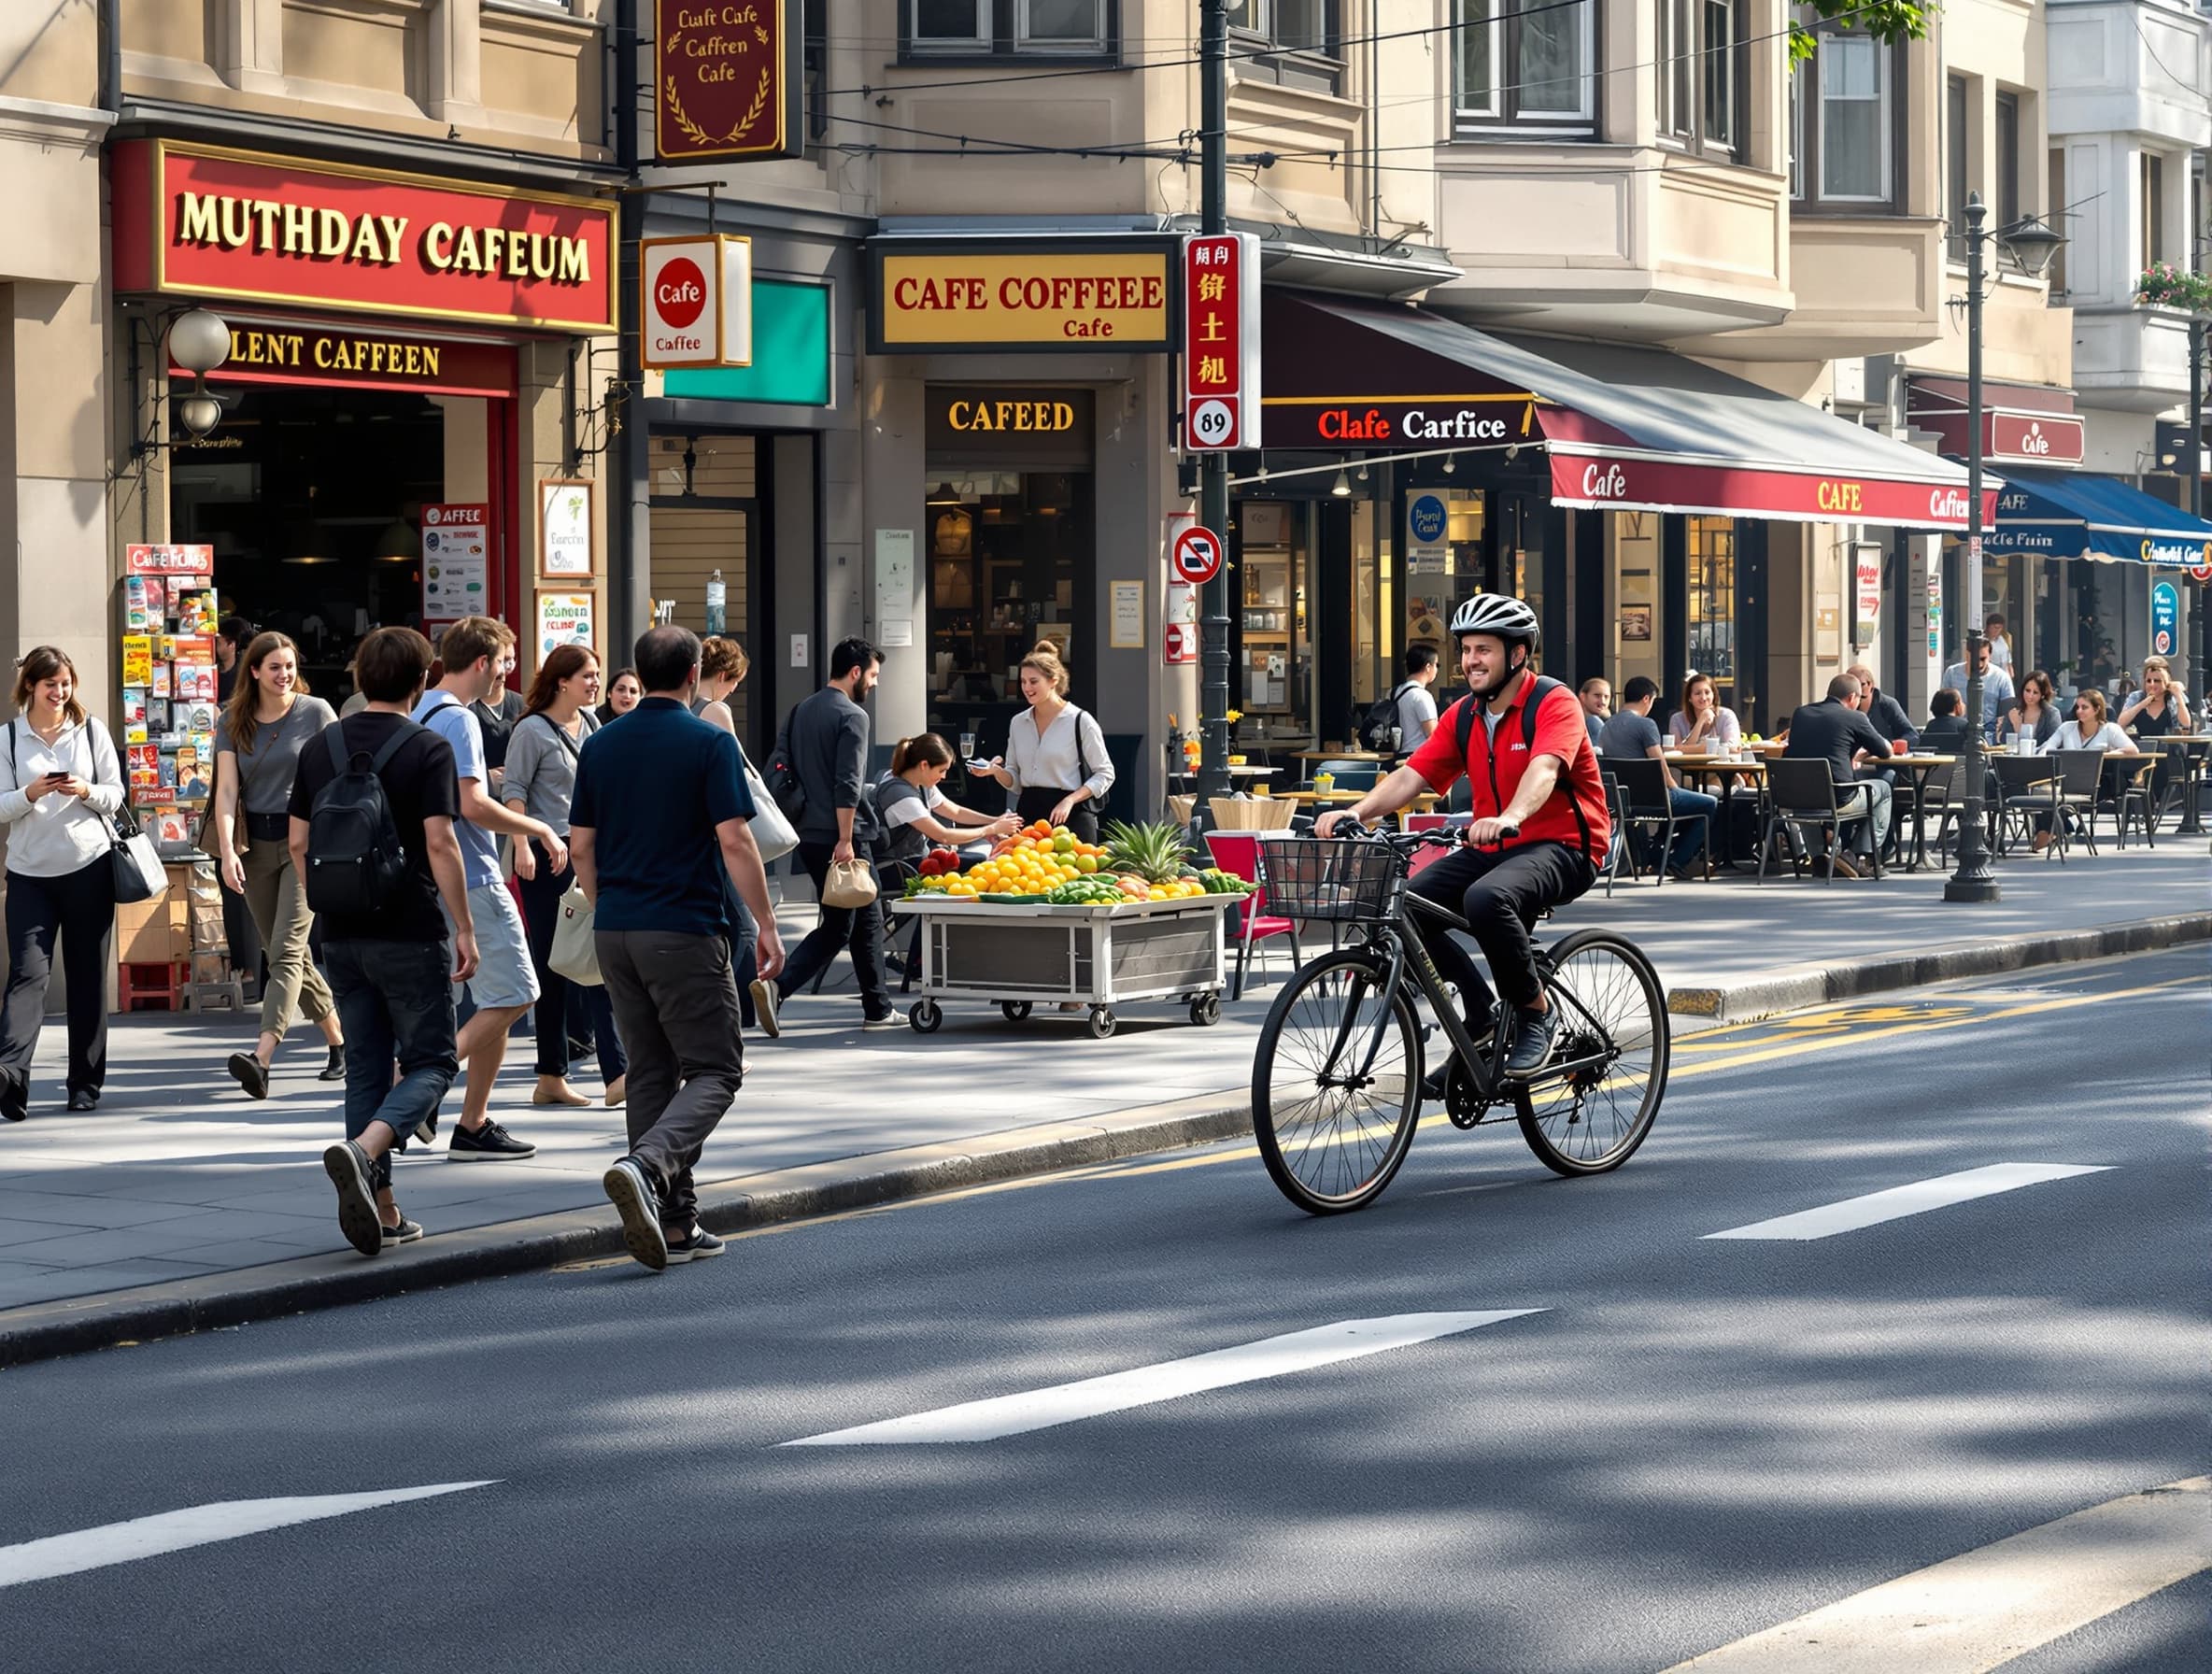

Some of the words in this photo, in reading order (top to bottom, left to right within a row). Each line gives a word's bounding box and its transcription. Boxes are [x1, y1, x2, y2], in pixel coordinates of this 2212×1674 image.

[698, 62, 736, 83] Cafe
[180, 192, 409, 263] MUTHDAY
[426, 221, 591, 282] CAFEUM
[659, 280, 702, 305] Cafe
[894, 277, 988, 311] CAFE
[999, 276, 1164, 310] COFFEEE
[1063, 318, 1113, 337] Cafe
[314, 337, 440, 376] CAFFEEN
[948, 401, 1073, 432] CAFEED
[1201, 413, 1226, 433] 89
[1318, 409, 1391, 440] Clafe
[1402, 410, 1507, 439] Carfice
[2021, 433, 2049, 455] Cafe
[1582, 463, 1627, 498] Cafe
[1818, 480, 1863, 512] CAFE
